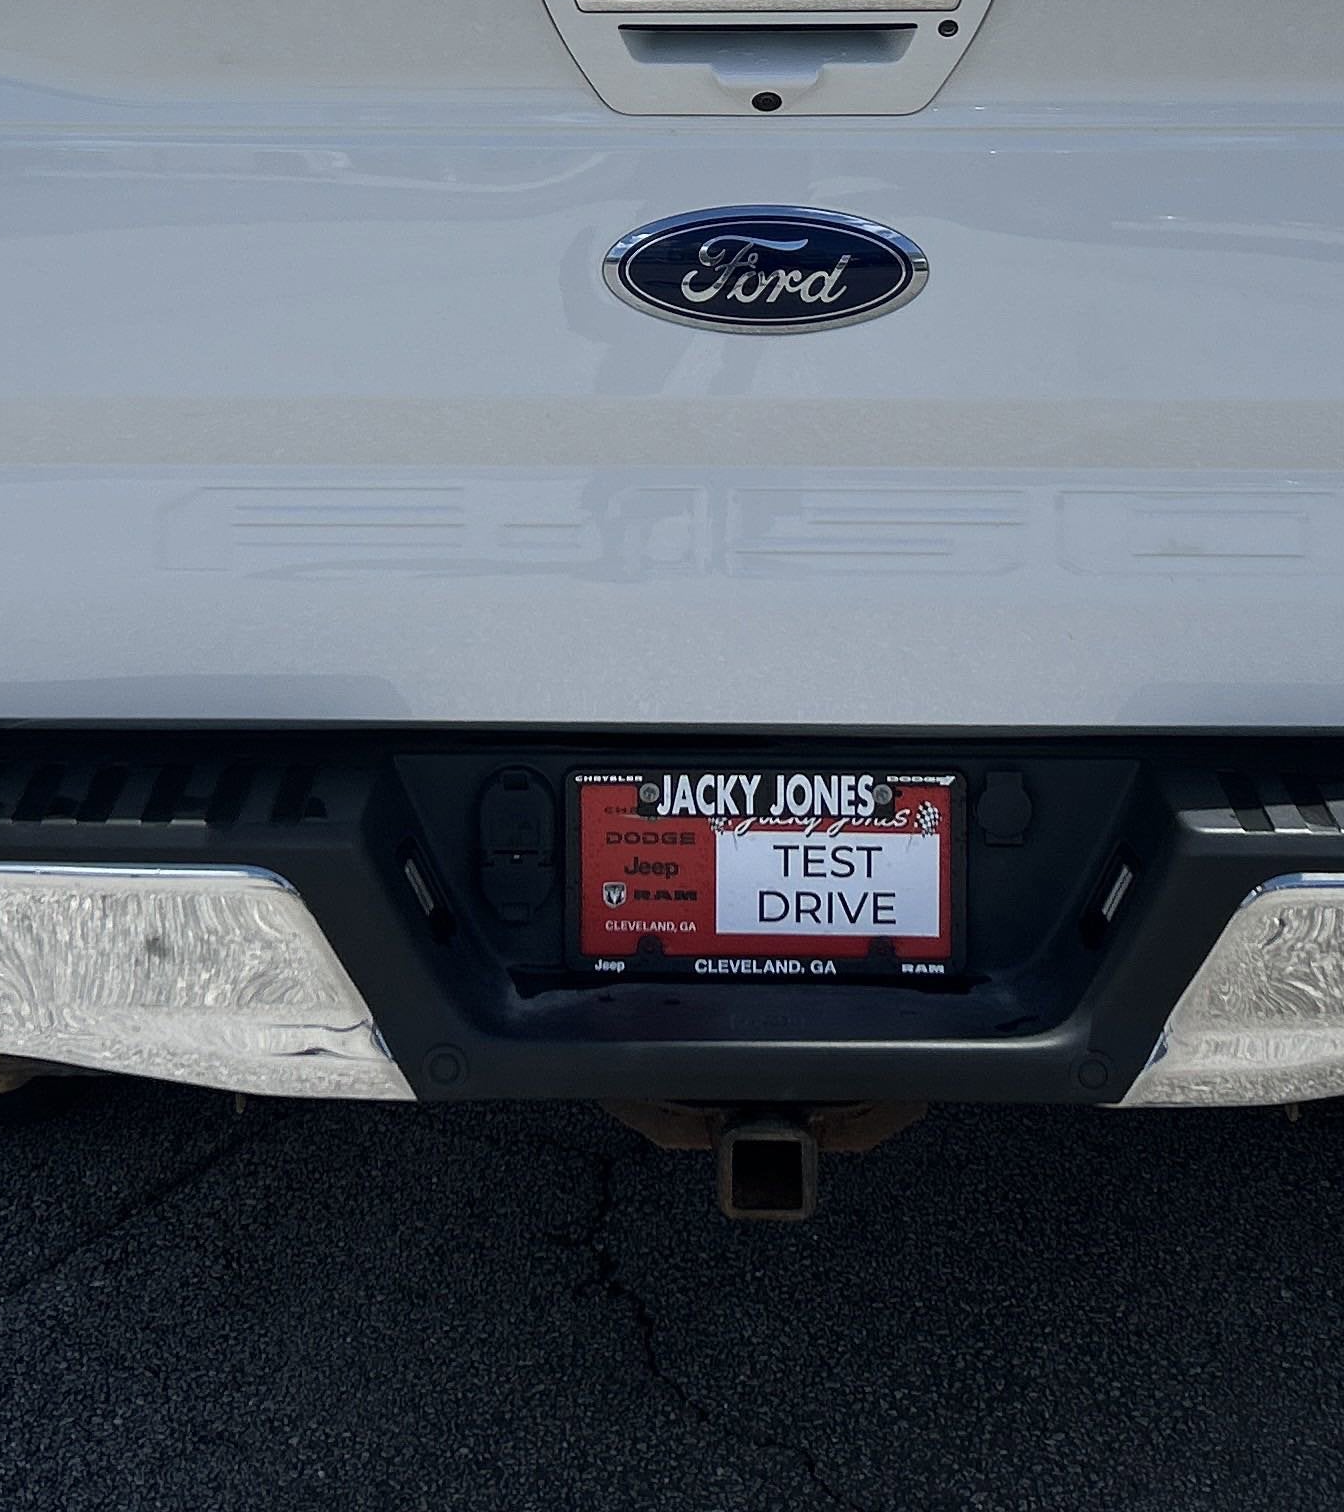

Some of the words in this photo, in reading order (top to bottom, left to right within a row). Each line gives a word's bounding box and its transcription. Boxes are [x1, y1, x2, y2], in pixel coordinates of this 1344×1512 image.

[681, 234, 853, 303] Ford
[657, 774, 762, 816] JACKY
[770, 774, 875, 817] JONES
[606, 831, 696, 845] DODGE
[623, 856, 679, 880] Jeep
[773, 845, 883, 879] TEST
[634, 890, 697, 901] RAM
[758, 890, 897, 925] DRIVE
[605, 920, 677, 932] CLEVELAND,
[680, 921, 697, 932] GA
[594, 959, 625, 973] Jeep
[810, 960, 837, 975] GA
[901, 964, 945, 974] RAM
